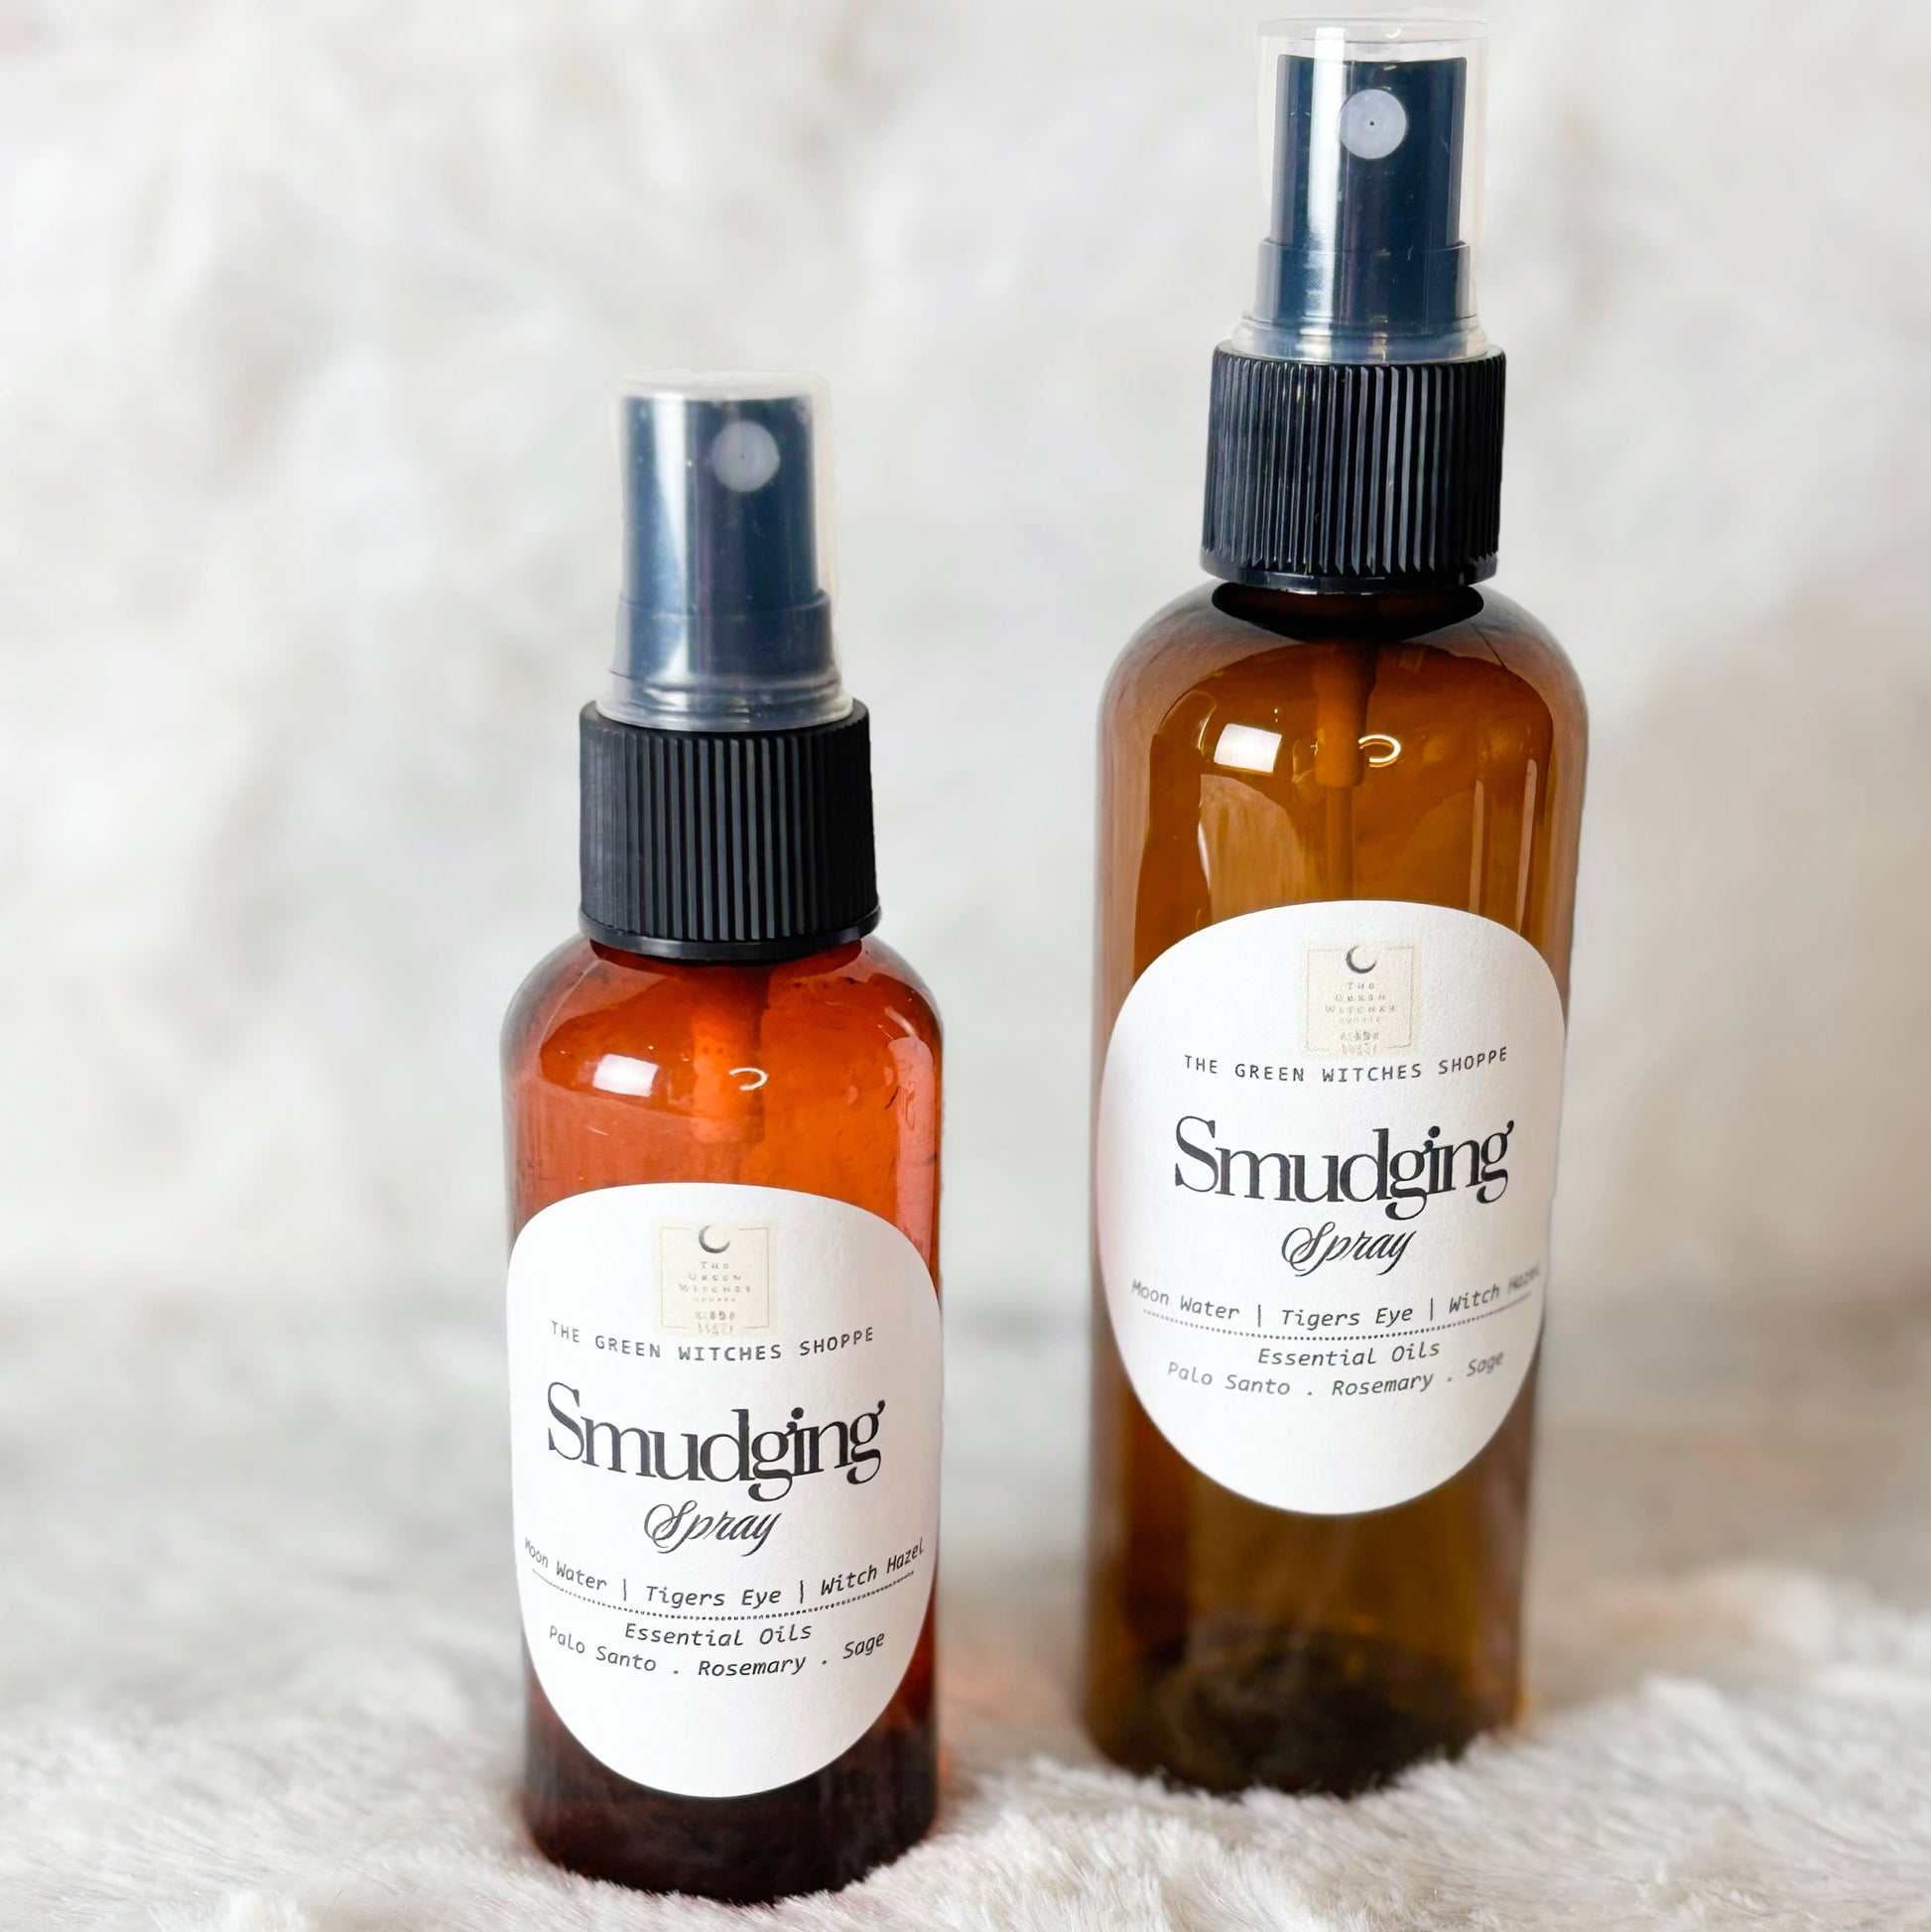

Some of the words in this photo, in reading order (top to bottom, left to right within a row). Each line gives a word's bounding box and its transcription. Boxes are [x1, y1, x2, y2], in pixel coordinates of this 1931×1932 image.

[1183, 1054, 1219, 1074] THE
[1233, 1063, 1306, 1083] GREEN
[1321, 1063, 1422, 1083] WITCHES
[1438, 1046, 1509, 1075] SHOPPE
[1175, 1114, 1515, 1220] Smudging
[1280, 1221, 1417, 1277] Spray
[1130, 1278, 1171, 1307] Moon
[1179, 1295, 1241, 1321] Water
[1281, 1308, 1361, 1331] Tigers
[1374, 1307, 1415, 1329] Eye
[1449, 1285, 1500, 1314] Witch
[551, 1319, 581, 1344] THE
[594, 1335, 661, 1358] GREEN
[678, 1344, 783, 1361] WITCHES
[799, 1326, 874, 1356] SHOPPE
[1257, 1348, 1376, 1367] Essential
[1391, 1341, 1441, 1363] Oils
[1167, 1361, 1214, 1386] Palo
[1224, 1373, 1291, 1396] Santo
[1331, 1370, 1435, 1398] Rosemary
[1466, 1350, 1506, 1377] Sage
[547, 1380, 885, 1502] Smudging
[643, 1499, 784, 1557] Spray
[523, 1536, 550, 1570] Moon
[555, 1560, 608, 1591] Water
[645, 1585, 726, 1608] Tigers
[740, 1587, 782, 1608] Eye
[820, 1565, 878, 1597] Witch
[886, 1536, 925, 1576] Hazel
[548, 1624, 586, 1654] Palo
[595, 1645, 657, 1673] Santo
[698, 1654, 807, 1677] Rosemary
[842, 1629, 885, 1660] Sage
[624, 1622, 744, 1647] Essential
[758, 1623, 813, 1645] Oils
